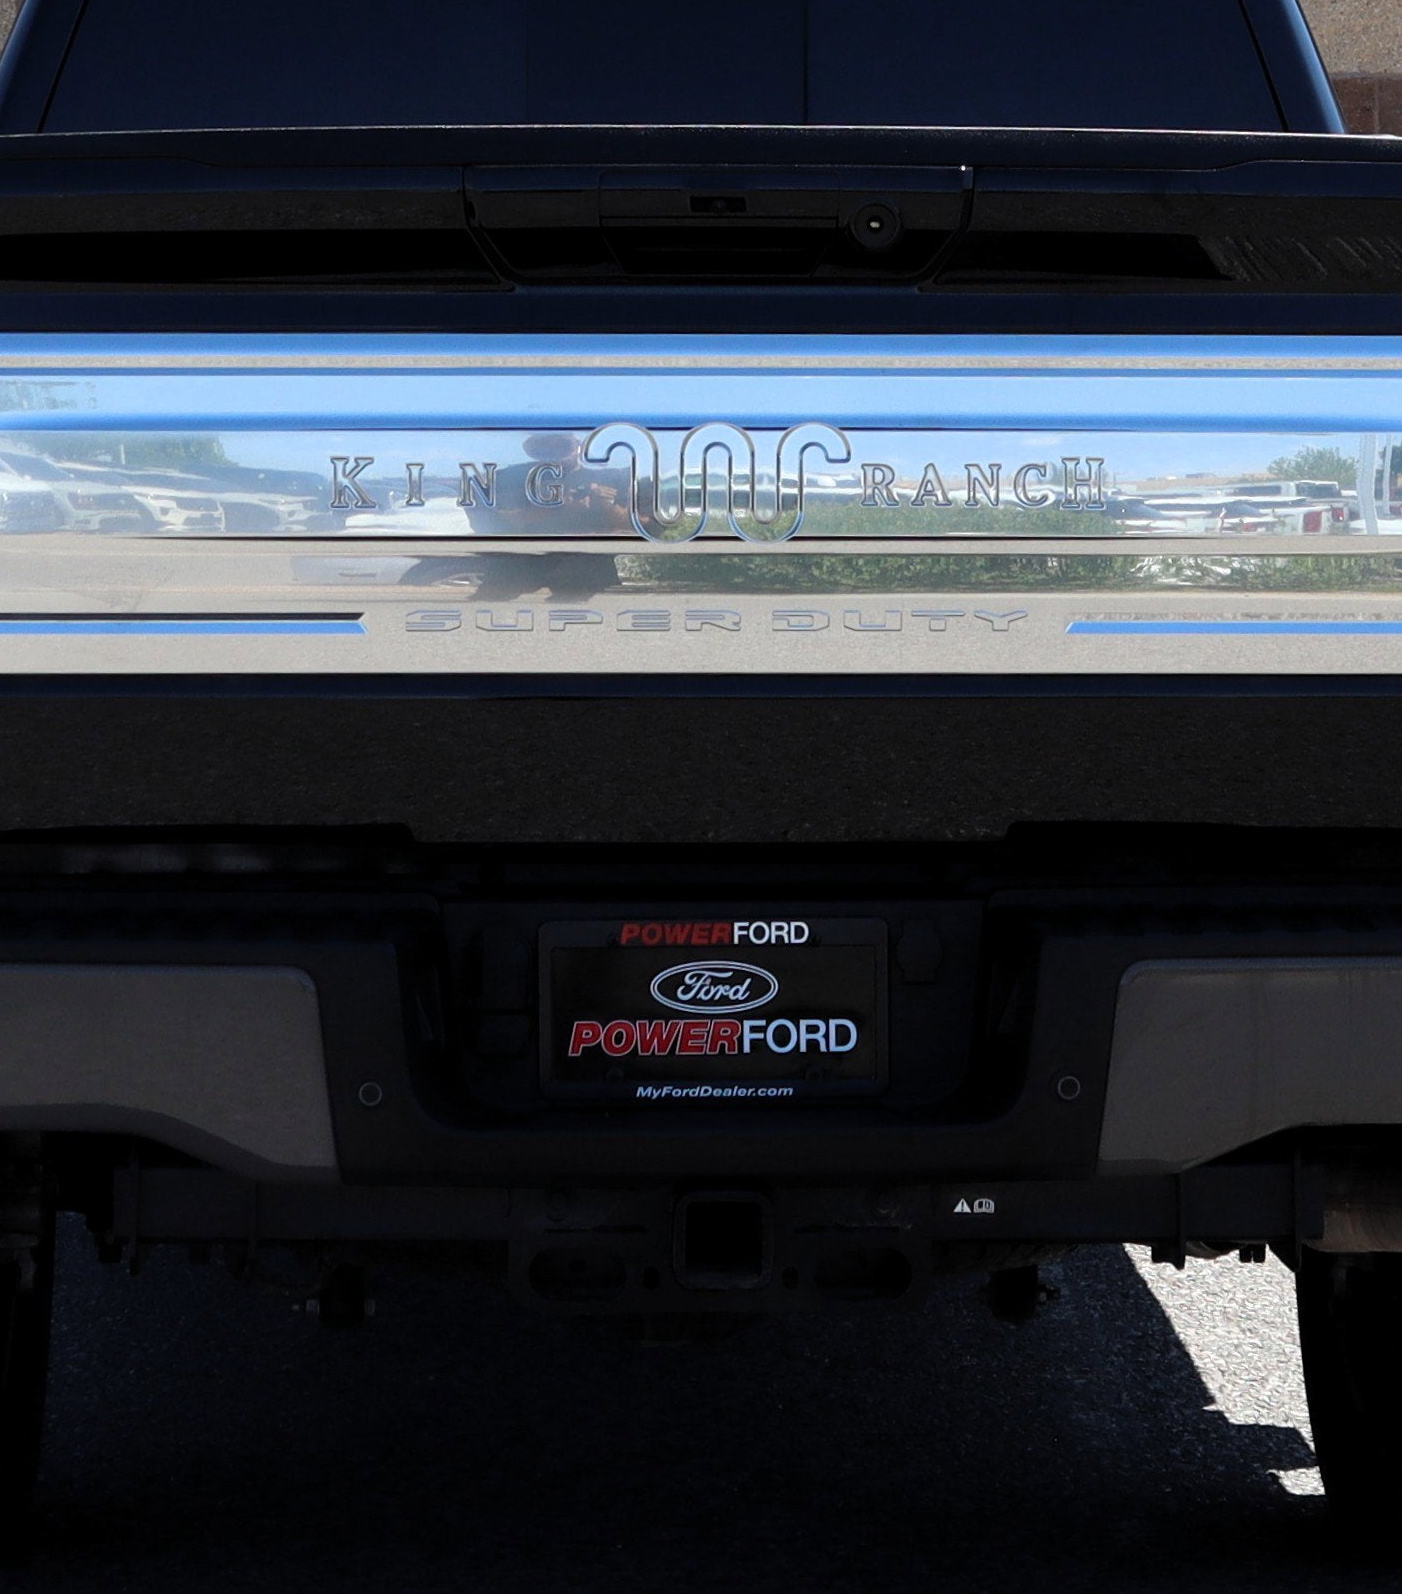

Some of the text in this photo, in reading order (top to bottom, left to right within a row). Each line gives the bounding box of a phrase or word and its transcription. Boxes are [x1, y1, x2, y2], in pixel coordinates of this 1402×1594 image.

[329, 455, 1107, 511] KING RANCH
[404, 609, 1030, 634] SUPER DUTY
[677, 970, 752, 1002] Ford
[636, 1085, 794, 1100] MyFordDealer.com
